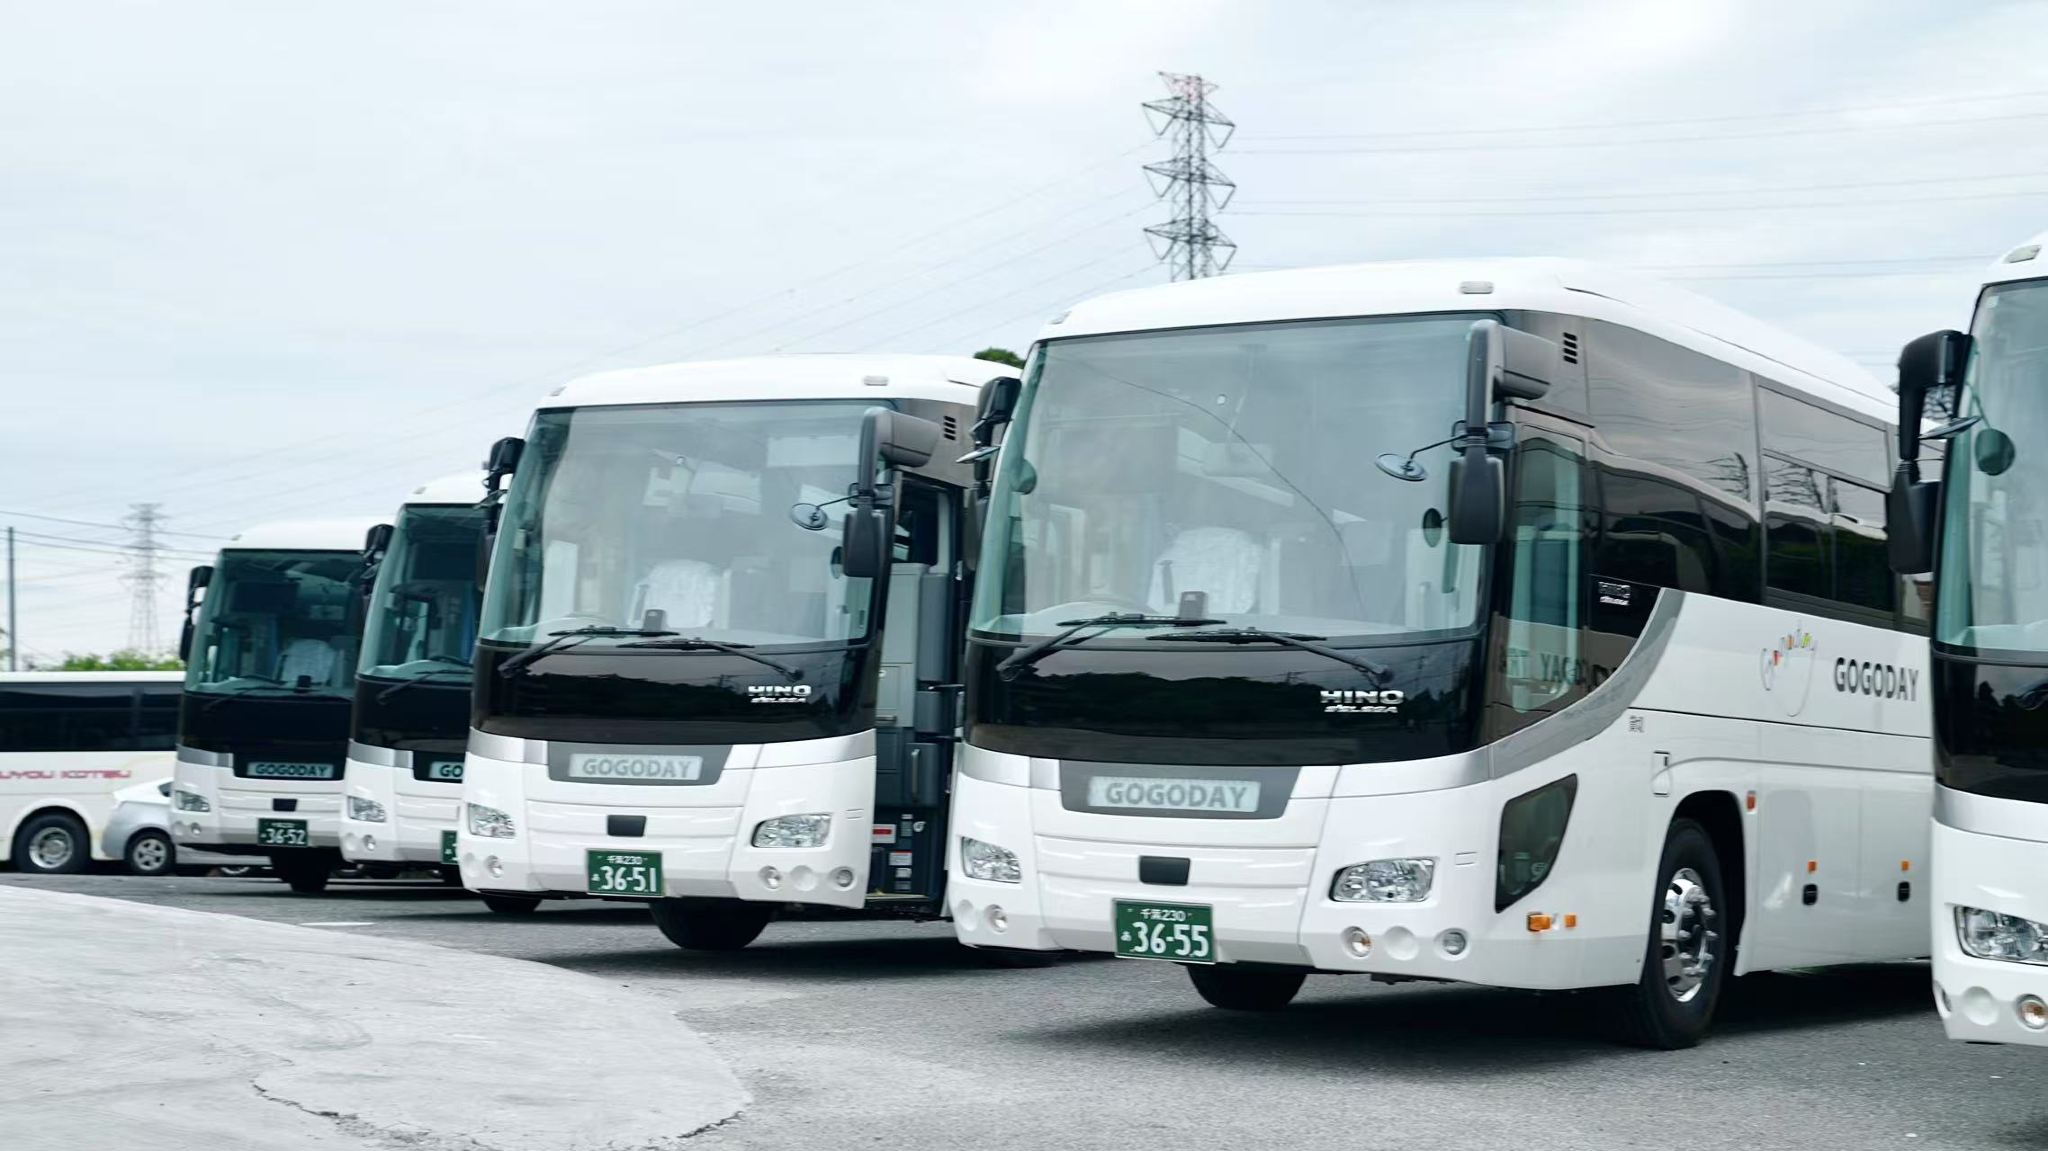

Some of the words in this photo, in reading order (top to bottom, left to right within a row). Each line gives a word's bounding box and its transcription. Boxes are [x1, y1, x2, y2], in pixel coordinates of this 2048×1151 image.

[1834, 656, 1919, 701] GOGODAY
[748, 685, 812, 697] HINO
[1320, 690, 1404, 704] HINO
[255, 763, 329, 776] GOGODAY
[582, 758, 692, 778] GOGODAY
[1106, 782, 1247, 809] GOGODAY
[265, 828, 306, 845] 36-52
[600, 865, 656, 892] 36-51
[1132, 921, 1209, 957] 36-55
